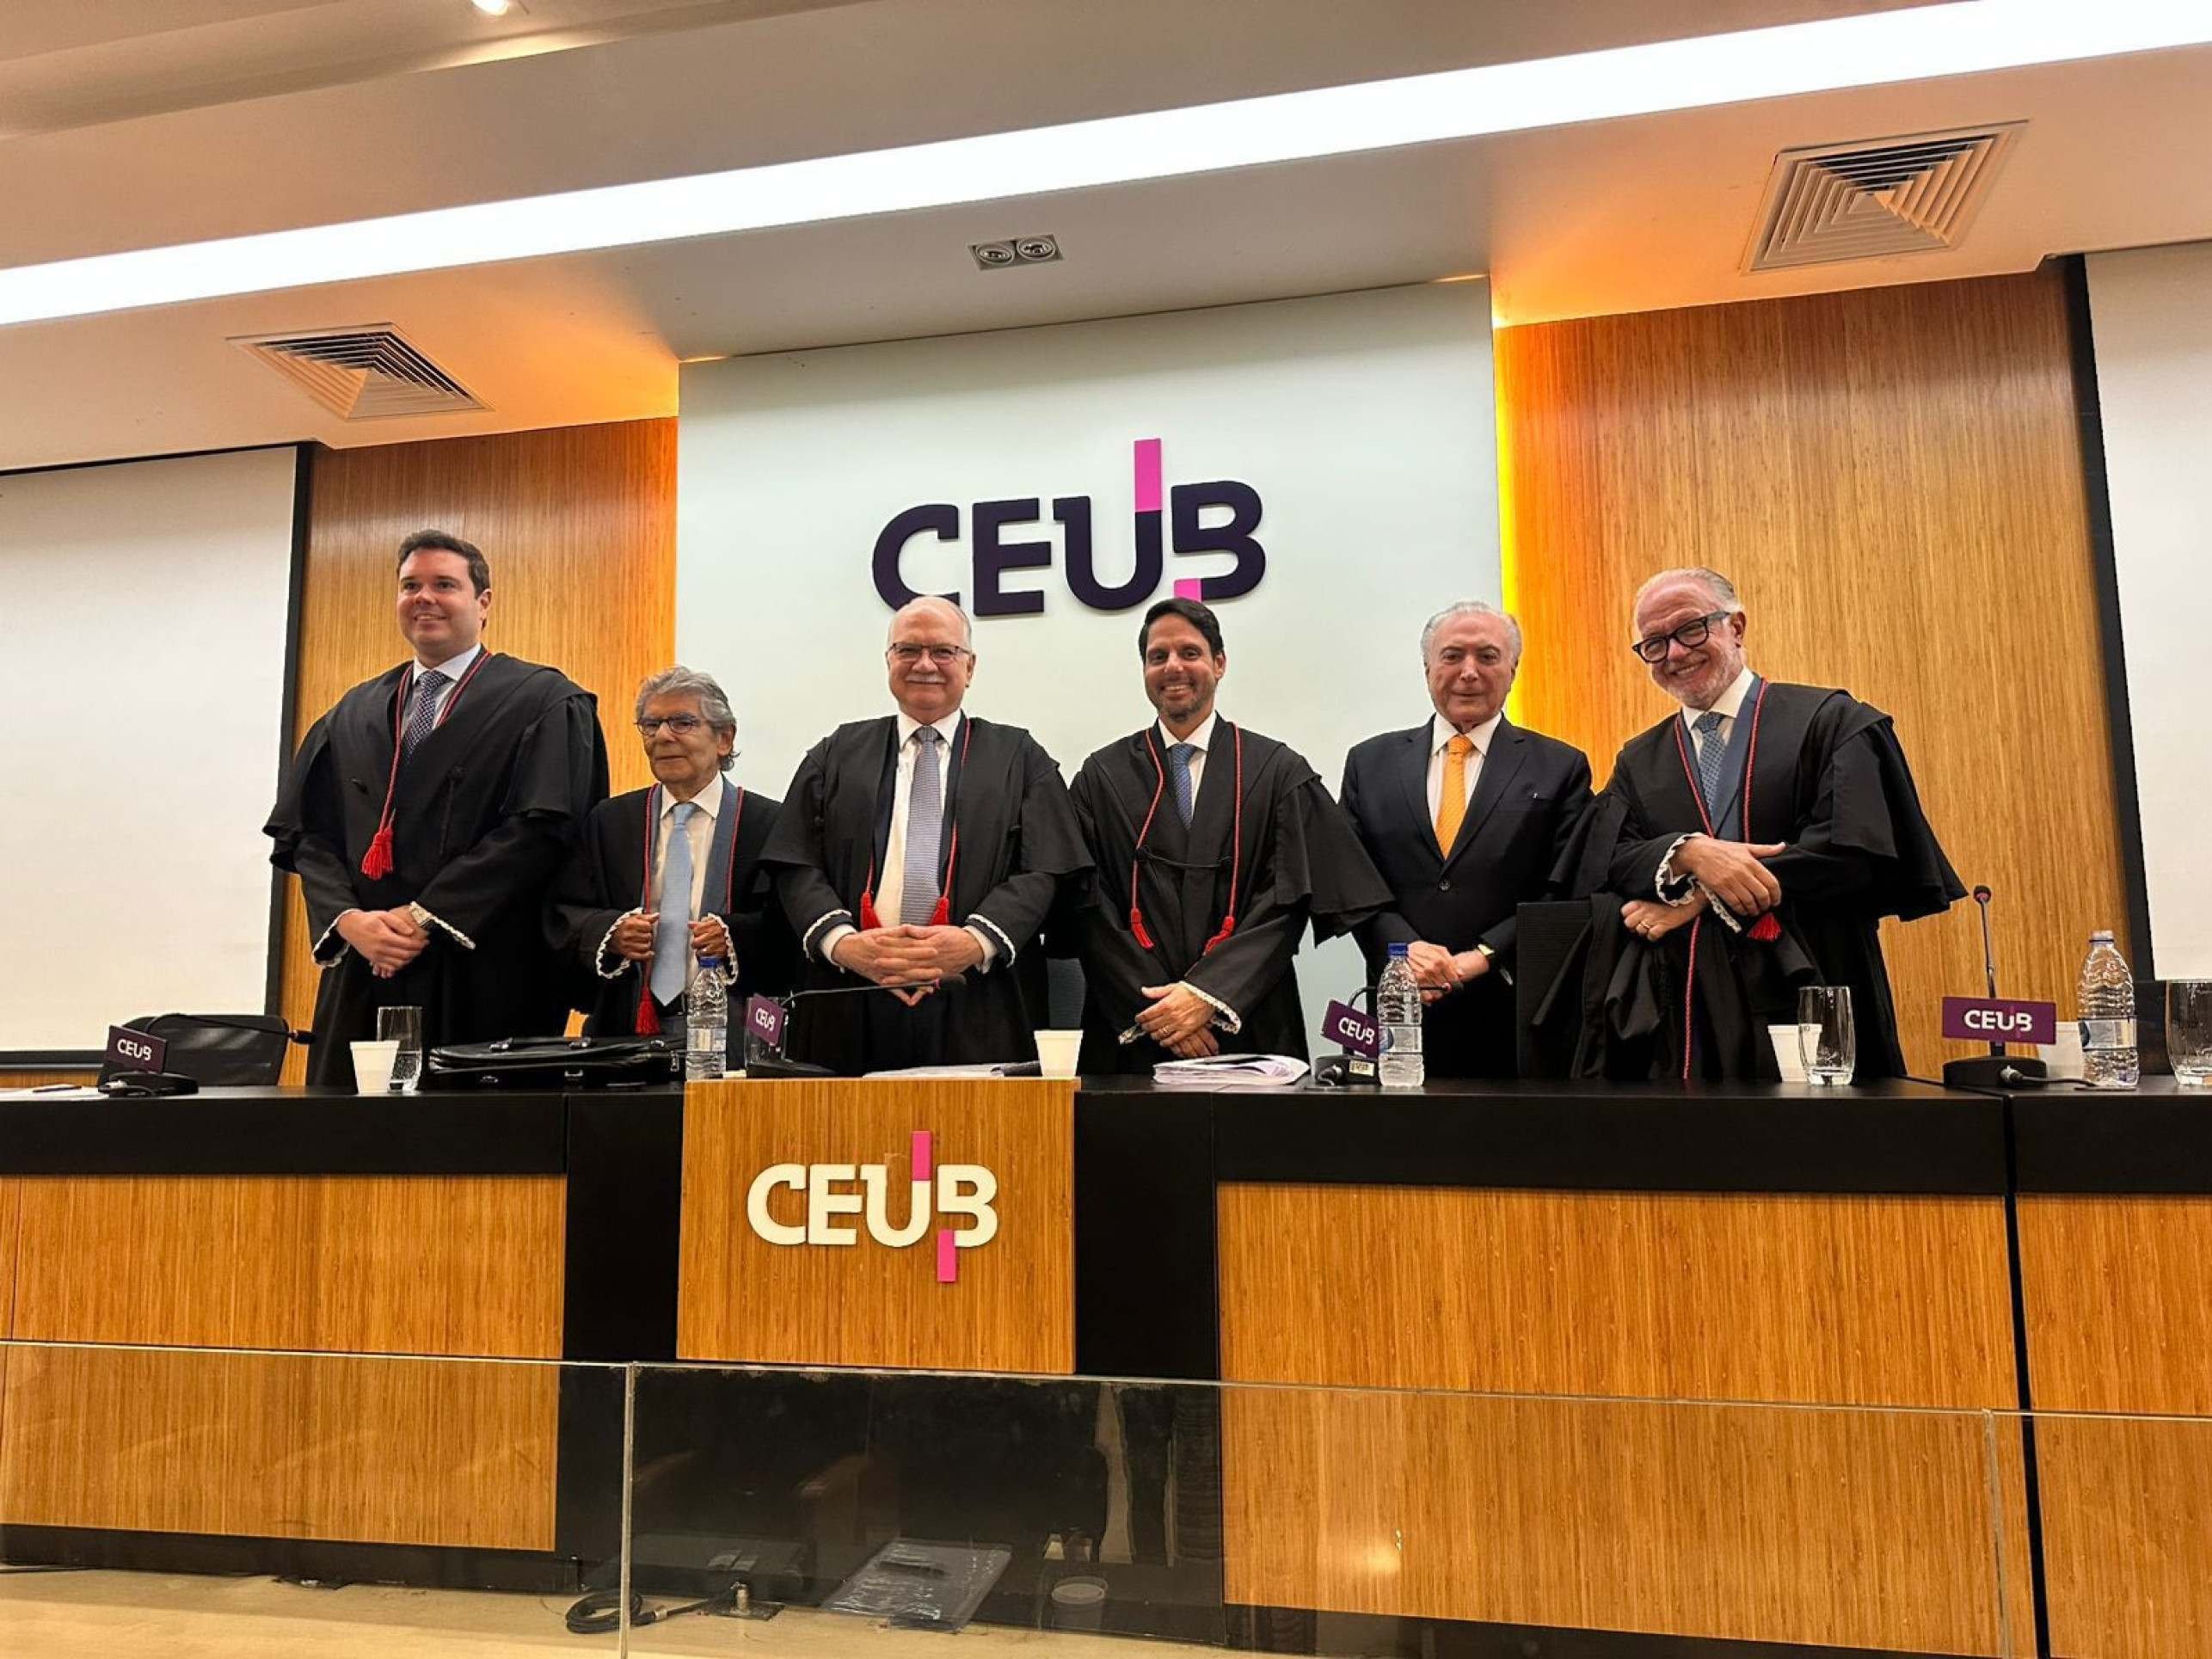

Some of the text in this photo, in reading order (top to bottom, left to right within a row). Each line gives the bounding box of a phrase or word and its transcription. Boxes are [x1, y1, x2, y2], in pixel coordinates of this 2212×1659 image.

[872, 438, 1266, 618] CEUB
[1338, 1017, 1376, 1045] CEUB
[1963, 1009, 2032, 1035] CEUB
[117, 1039, 152, 1061] CEUB
[747, 1129, 998, 1283] CEUB
